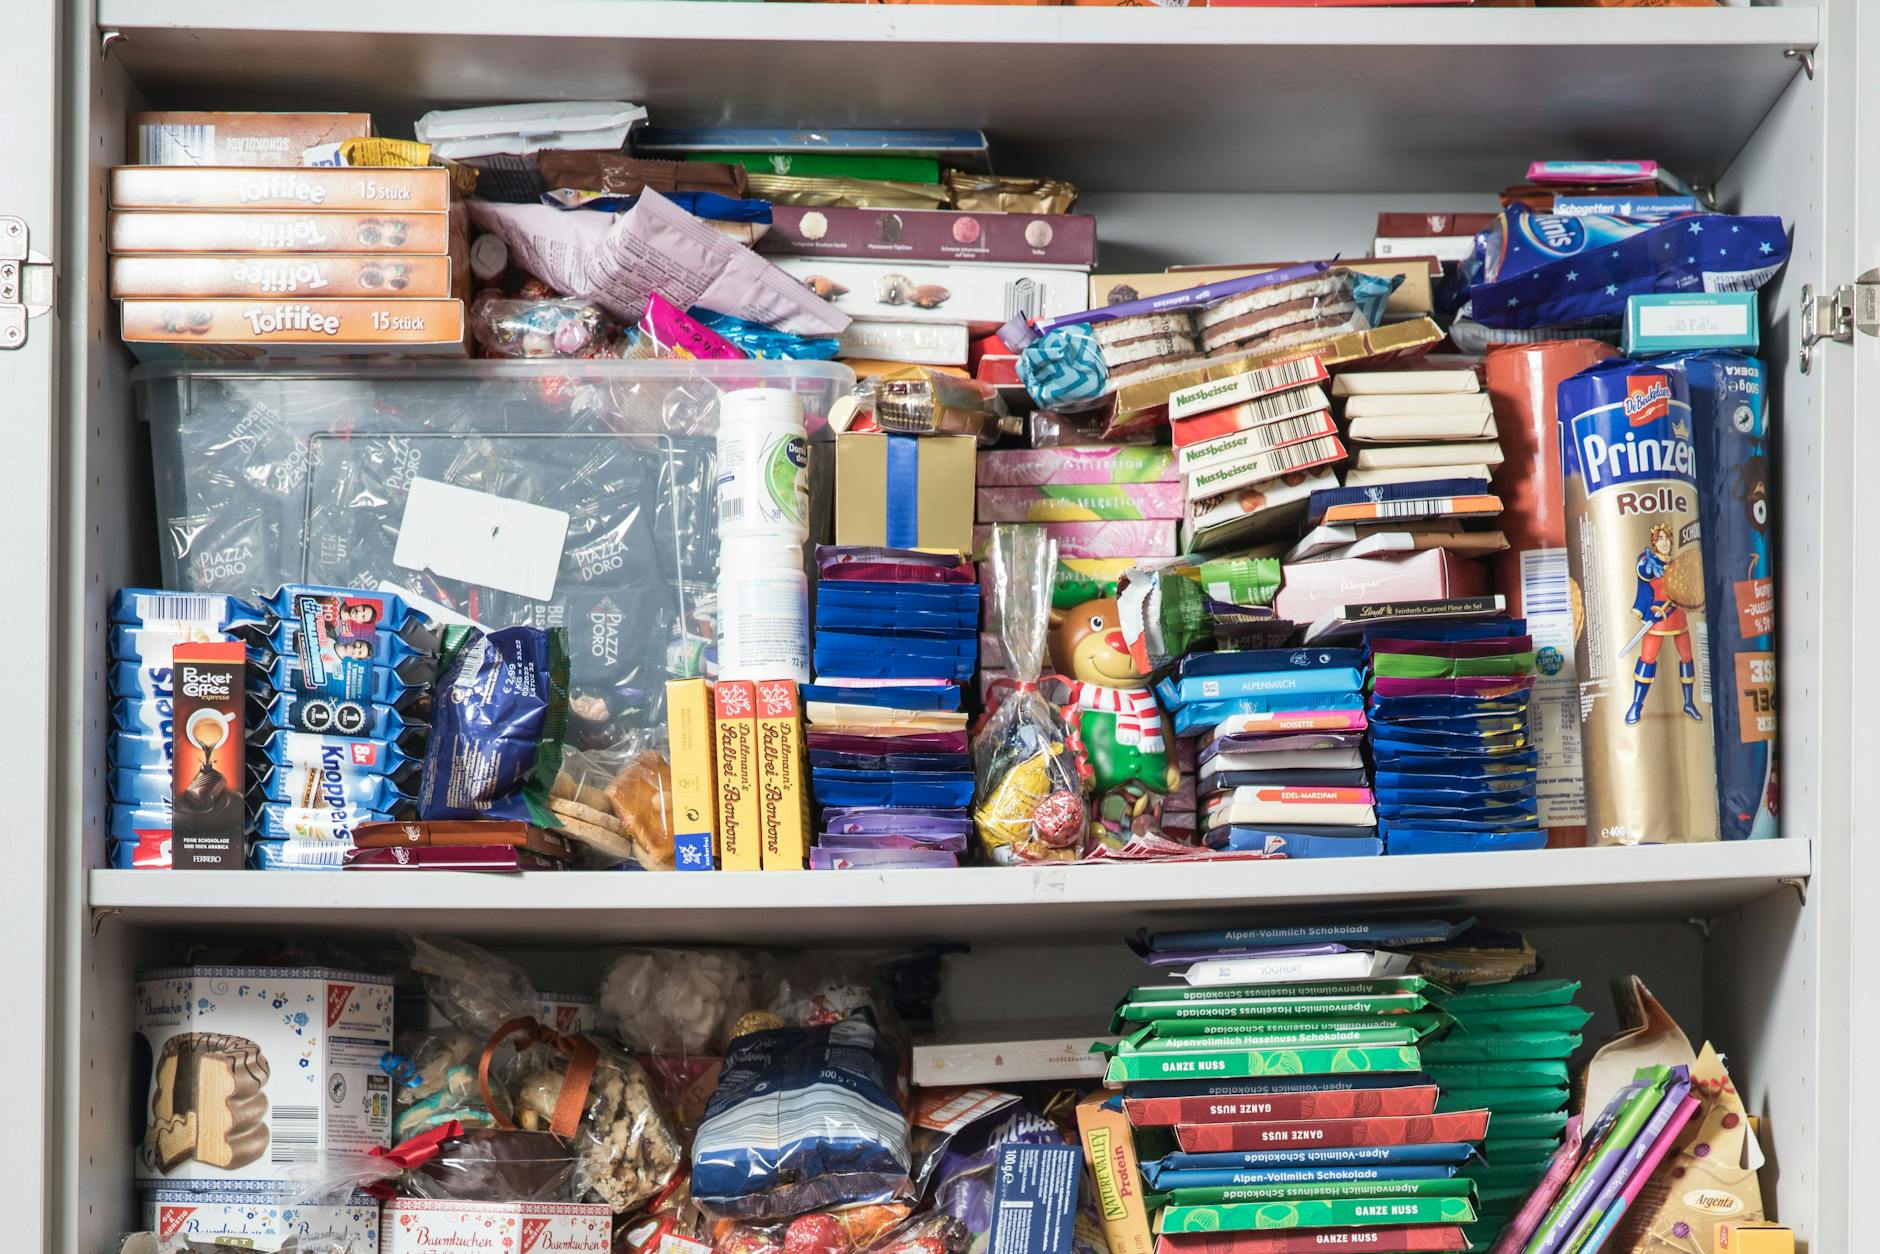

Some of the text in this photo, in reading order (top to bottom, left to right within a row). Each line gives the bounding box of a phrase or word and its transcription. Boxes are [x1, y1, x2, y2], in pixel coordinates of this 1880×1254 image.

[237, 175, 411, 203] Toffifee 15 Stück
[1559, 204, 1615, 216] Schogetten
[232, 219, 327, 248] Toffifee
[233, 262, 328, 292] Toffifee
[244, 305, 424, 336] Toffifee 15 Stück
[1725, 366, 1759, 376] EDEKA
[1176, 382, 1239, 407] Nussbeisser
[1185, 436, 1248, 462] Nussbeisser
[1583, 432, 1697, 484] Prinzen
[1196, 461, 1258, 487] Nussbeisser
[1616, 488, 1688, 516] Rolle
[199, 546, 254, 569] PIAZZA
[1360, 605, 1385, 617] Lindt
[1395, 607, 1422, 615] Feinherb
[1423, 605, 1447, 614] Caramel
[183, 667, 233, 684] Pocket
[505, 664, 517, 685] 2,99
[183, 682, 230, 698] Coffee
[1242, 678, 1296, 691] ALPENMILCH
[1280, 719, 1313, 729] NOISETTE
[354, 744, 371, 763] 8x
[738, 722, 751, 792] Dallmann's
[779, 721, 792, 792] Dallmann's
[321, 744, 350, 841] Knoppers
[720, 722, 741, 854] Salbei-Bonbons
[761, 721, 782, 855] Salbei-Bonbons
[1281, 790, 1337, 800] EDEL-MARZIPAN
[193, 855, 222, 863] FERRERO
[1225, 924, 1369, 941] Alpen-Vollmilch Schokolade
[1184, 985, 1373, 1000] Alpenvollmilch Haselnuss Schokolade
[1176, 1003, 1371, 1018] Alpenvollmilch Haselnuss Schokolade
[1204, 1023, 1264, 1034] Schokolade
[1166, 1031, 1360, 1048] Alpenvollmilch Haselnuss Schokolade
[1162, 1060, 1226, 1072] GANZE NUSS
[1209, 1082, 1353, 1096] Alpen-Vollmilch Schokolade
[1210, 1104, 1272, 1115] GANZE NUSS
[988, 1112, 1058, 1149] Milka
[1262, 1129, 1323, 1141] GANZE NUSS
[1244, 1148, 1389, 1163] Alpen-Vollmilch Schokolade
[1090, 1132, 1124, 1217] NATURE VALLEY
[1115, 1145, 1132, 1197] Protein
[1233, 1169, 1378, 1183] Alpen-Vollmilch Schokolade
[1223, 1183, 1419, 1200] Alpenvollmilch Haselnuss Schokolade
[1695, 1191, 1735, 1209] Argenta
[1355, 1204, 1419, 1216] GANZE NUSS
[222, 1237, 249, 1245] TET
[417, 1227, 493, 1248] Baumkuchen
[543, 1231, 600, 1250] Baumkuchen
[1316, 1232, 1378, 1244] GANZE NUSS
